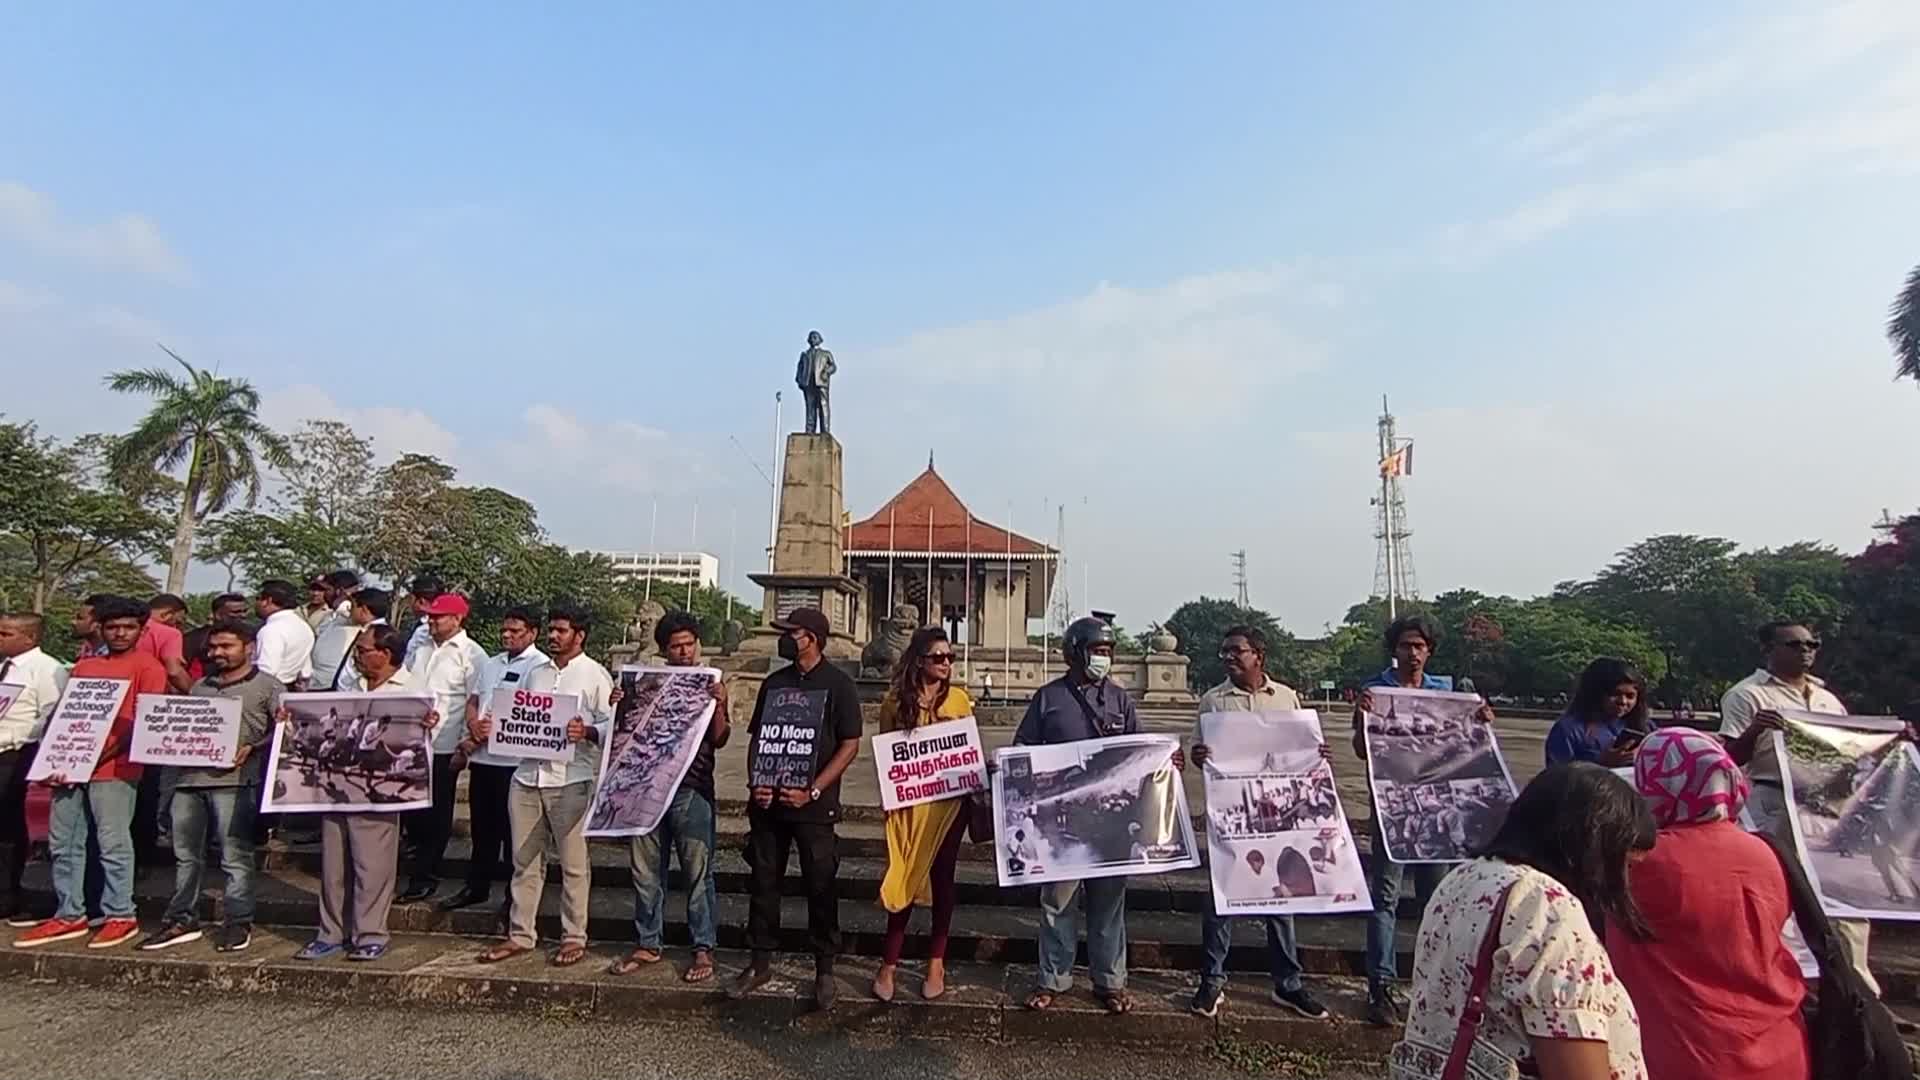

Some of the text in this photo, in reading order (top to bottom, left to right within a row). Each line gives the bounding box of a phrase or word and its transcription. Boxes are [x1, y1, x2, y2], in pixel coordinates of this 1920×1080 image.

[514, 690, 554, 711] Stop
[511, 707, 551, 724] State
[500, 718, 561, 737] Terror on
[760, 725, 815, 740] NO More
[496, 732, 567, 751] Democracy!
[758, 740, 812, 755] Tear Gas
[891, 732, 968, 762] இரசாயன
[754, 757, 810, 771] NO More
[888, 746, 979, 784] ஆயுதங்கள்
[752, 772, 808, 787] Tear Gas
[895, 769, 984, 802] வேண்டாம்
